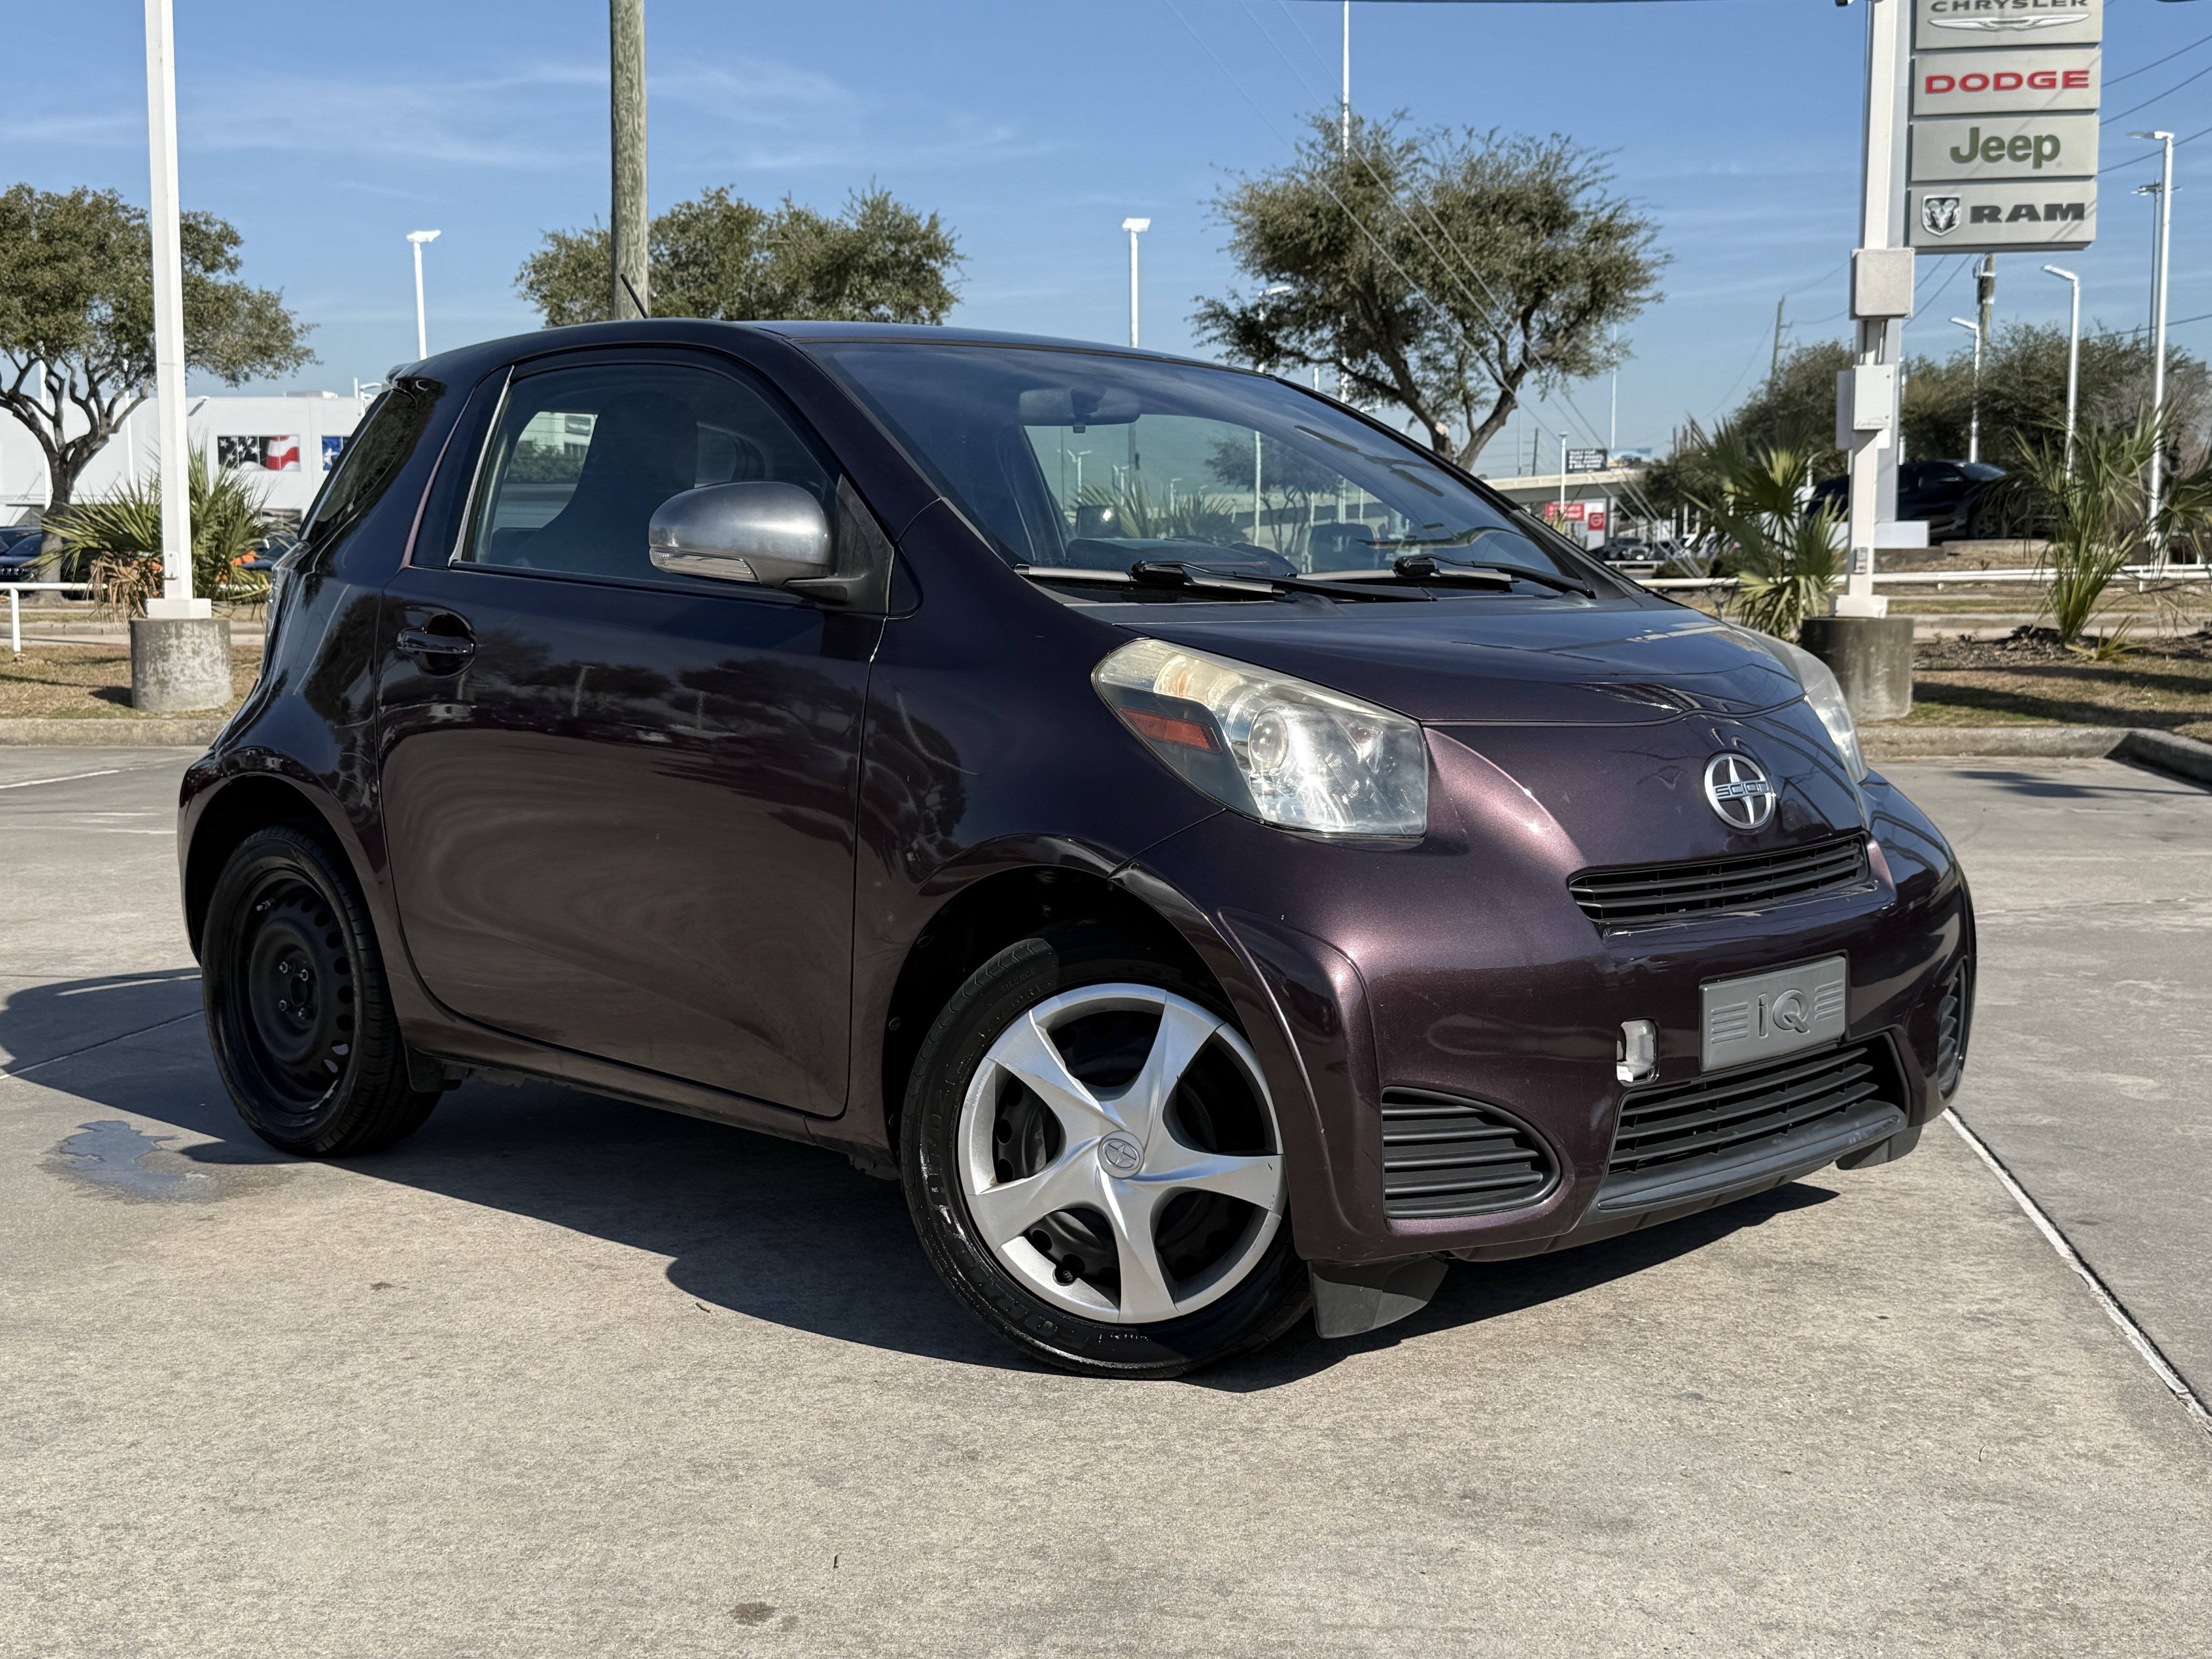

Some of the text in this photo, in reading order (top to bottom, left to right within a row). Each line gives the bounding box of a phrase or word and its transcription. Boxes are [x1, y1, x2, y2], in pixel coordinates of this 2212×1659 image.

[1930, 0, 2088, 12] CHRYSLER
[1925, 70, 2090, 94] DODGE
[1949, 127, 2061, 169] Jeep
[1970, 203, 2085, 224] RAM
[1758, 988, 1810, 1039] iQ
